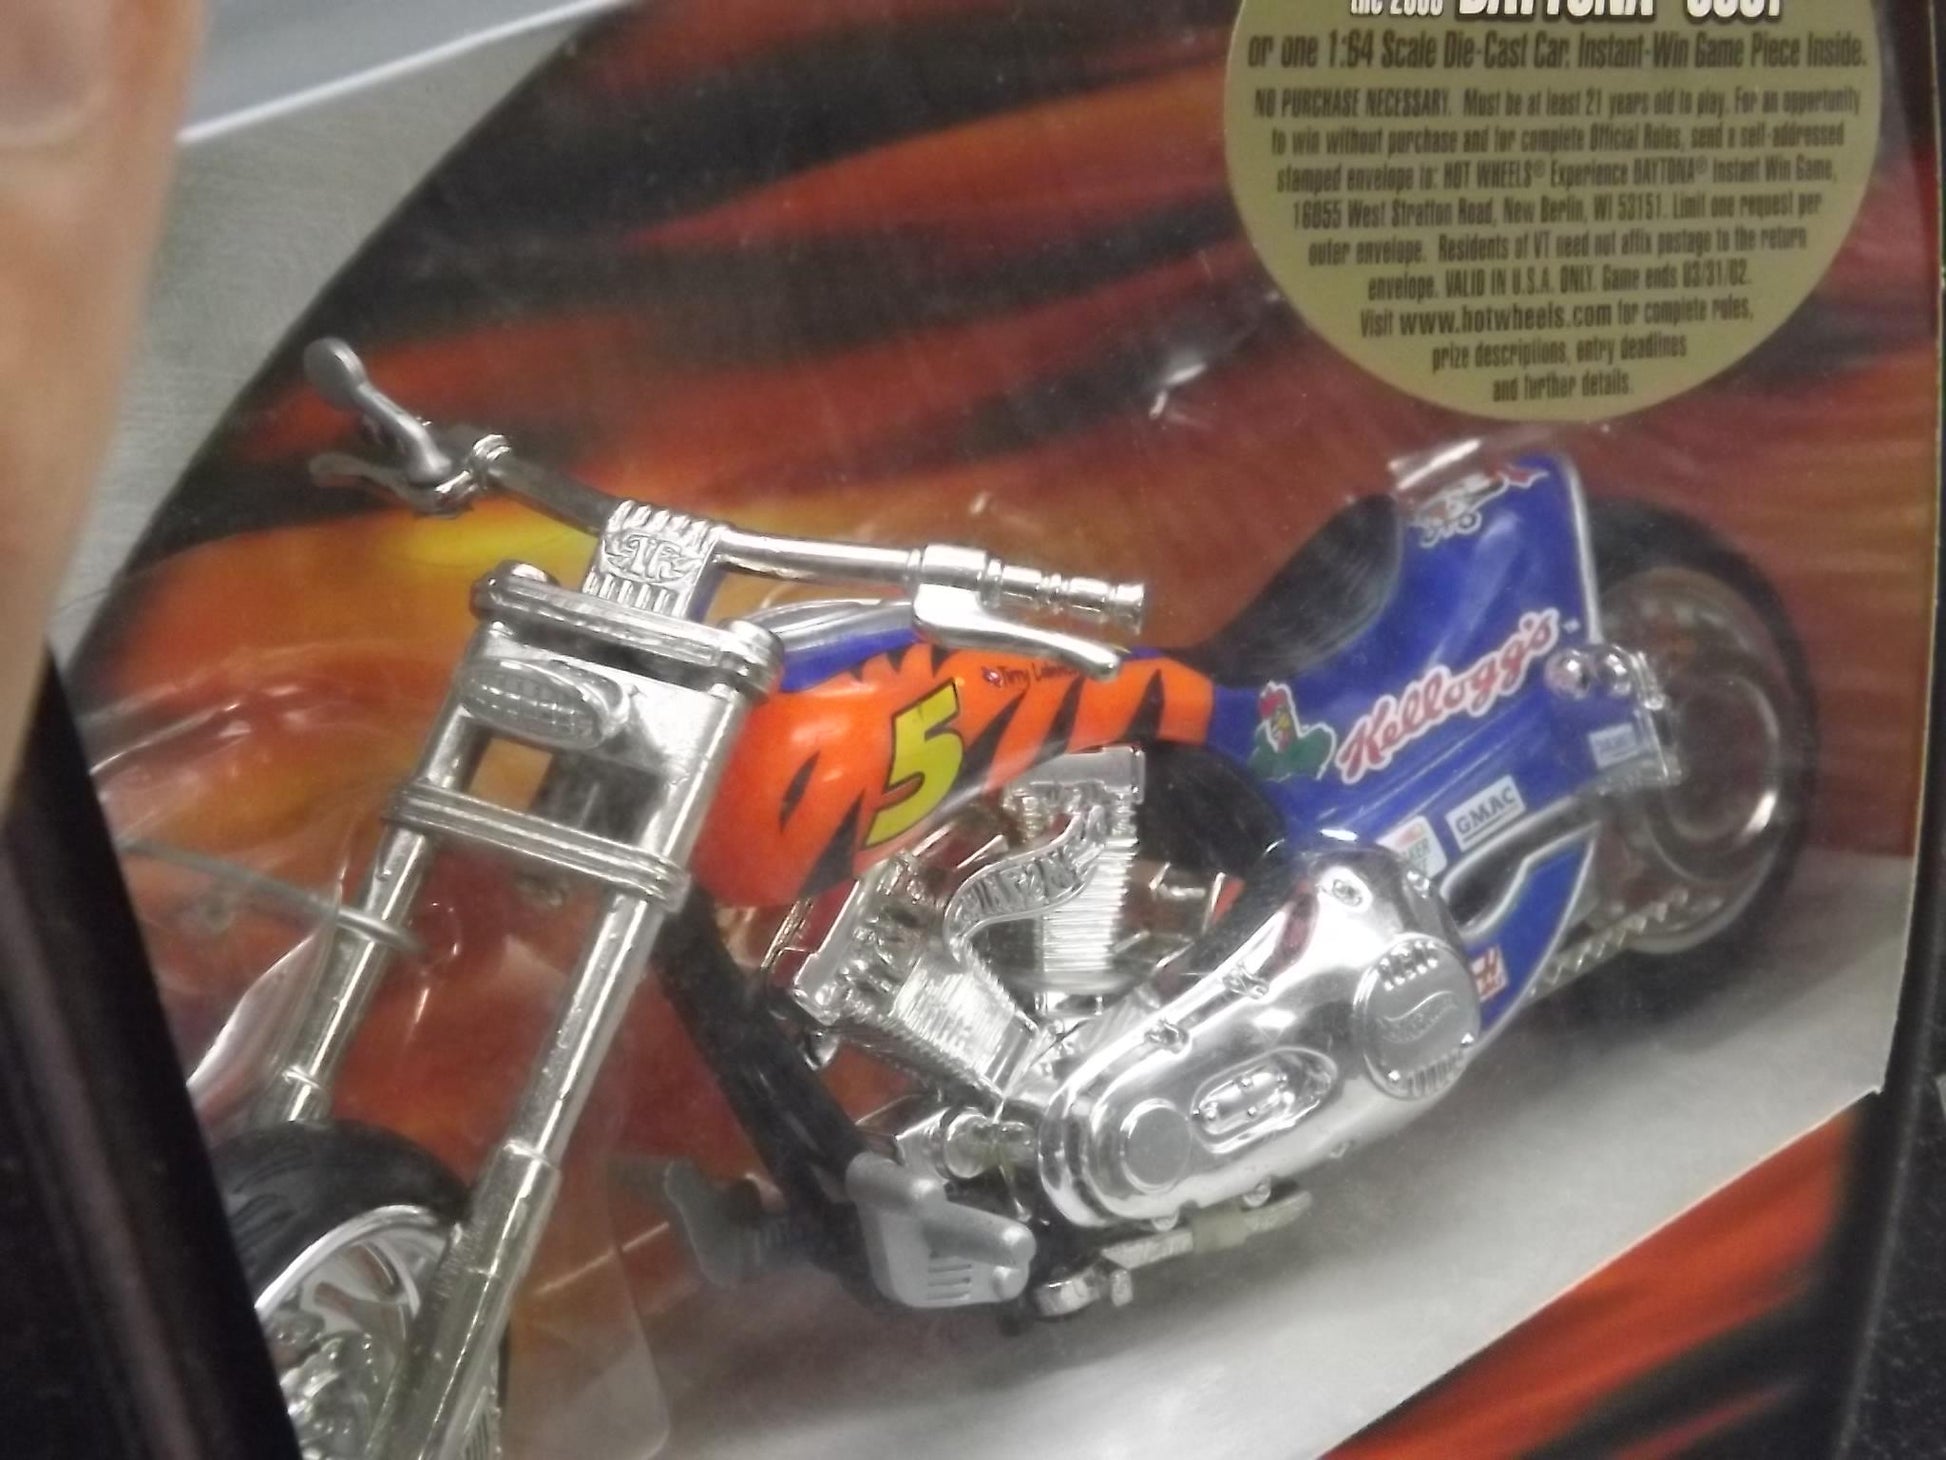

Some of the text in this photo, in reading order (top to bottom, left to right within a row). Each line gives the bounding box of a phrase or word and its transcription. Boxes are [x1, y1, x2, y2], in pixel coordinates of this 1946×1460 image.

[1248, 34, 1273, 67] or
[1281, 34, 1318, 67] one
[1328, 29, 1374, 68] 1:64
[1381, 29, 1437, 68] Scale
[1444, 30, 1528, 68] Die-Cast
[1578, 31, 1689, 68] Instant-Win
[1695, 31, 1744, 68] Game
[1752, 31, 1799, 68] Piece
[1254, 88, 1276, 118] NO
[1281, 88, 1360, 118] PURCHASE
[1463, 88, 1499, 117] Must
[1506, 89, 1522, 116] be
[1527, 88, 1542, 116] at
[1547, 88, 1580, 116] least
[1586, 88, 1601, 115] 21
[1609, 91, 1648, 118] years
[1655, 87, 1674, 115] old
[1680, 88, 1693, 115] to
[1735, 86, 1757, 113] For
[1783, 86, 1860, 117] opportunity
[1272, 128, 1286, 155] to
[1292, 128, 1320, 154] win
[1327, 126, 1383, 154] without
[1388, 126, 1458, 158] purchase
[1464, 127, 1489, 153] and
[1495, 127, 1516, 153] for
[1521, 126, 1584, 157] complete
[1590, 124, 1638, 151] Official
[1692, 123, 1723, 149] send
[1741, 122, 1845, 149] self-addressed
[1277, 164, 1342, 195] stamped
[1347, 163, 1414, 194] envelope
[1444, 161, 1470, 189] HOT
[1551, 159, 1629, 189] Experience
[1713, 156, 1760, 183] Instant
[1765, 156, 1791, 182] Win
[1348, 200, 1386, 227] West
[1392, 198, 1451, 227] Stratton
[1503, 196, 1534, 223] New
[1594, 194, 1612, 221] WI
[1673, 193, 1705, 219] Limit
[1711, 195, 1734, 217] one
[1740, 191, 1793, 220] request
[1798, 192, 1822, 218] per
[1308, 239, 1349, 266] outer
[1439, 234, 1509, 261] Residents
[1515, 233, 1529, 259] of
[1534, 231, 1551, 258] VT
[1556, 231, 1589, 257] need
[1595, 231, 1616, 256] not
[1621, 228, 1652, 255] affix
[1658, 229, 1711, 258] postage
[1716, 228, 1729, 252] to
[1735, 227, 1755, 251] the
[1760, 226, 1807, 250] return
[1445, 269, 1485, 298] VALID
[1491, 268, 1506, 296] IN
[1602, 264, 1640, 292] Game
[1645, 262, 1678, 289] ends
[1360, 308, 1393, 338] Visit
[1399, 302, 1612, 337] www.hotwheels.com
[1618, 300, 1639, 325] for
[1644, 297, 1706, 327] complete
[1432, 345, 1469, 374] prize
[1576, 336, 1615, 365] entry
[1620, 332, 1687, 360] deadlines
[1493, 376, 1519, 402] and
[1524, 372, 1576, 400] further
[1337, 608, 1559, 785] Kellogg's
[863, 678, 963, 850] 5
[1456, 785, 1516, 834] GMAC
